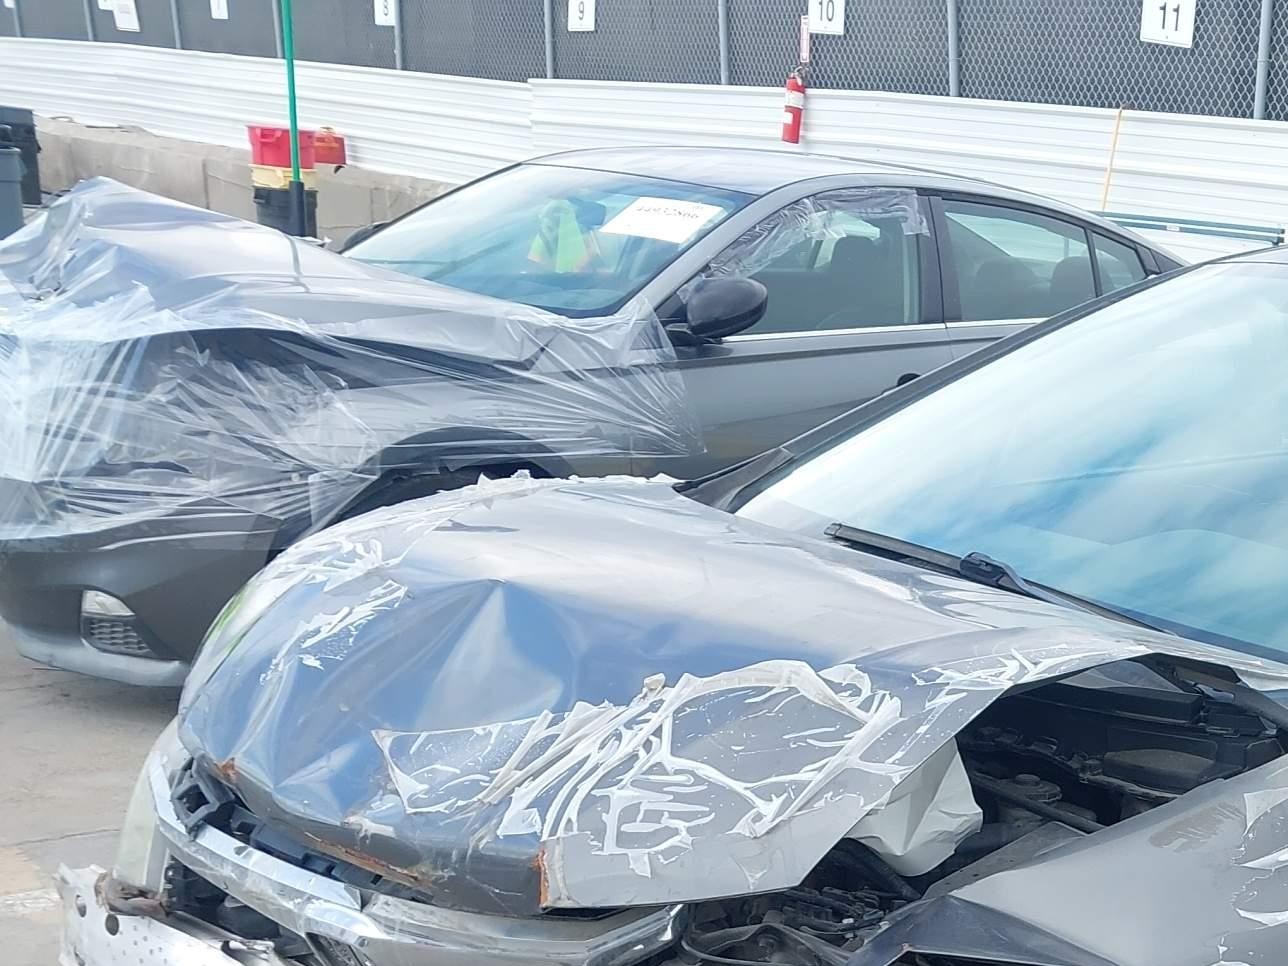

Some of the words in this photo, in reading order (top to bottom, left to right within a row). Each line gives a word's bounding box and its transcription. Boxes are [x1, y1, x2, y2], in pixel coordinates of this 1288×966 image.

[577, 1, 587, 21] 9
[818, 0, 836, 22] 10
[1159, 2, 1180, 32] 11
